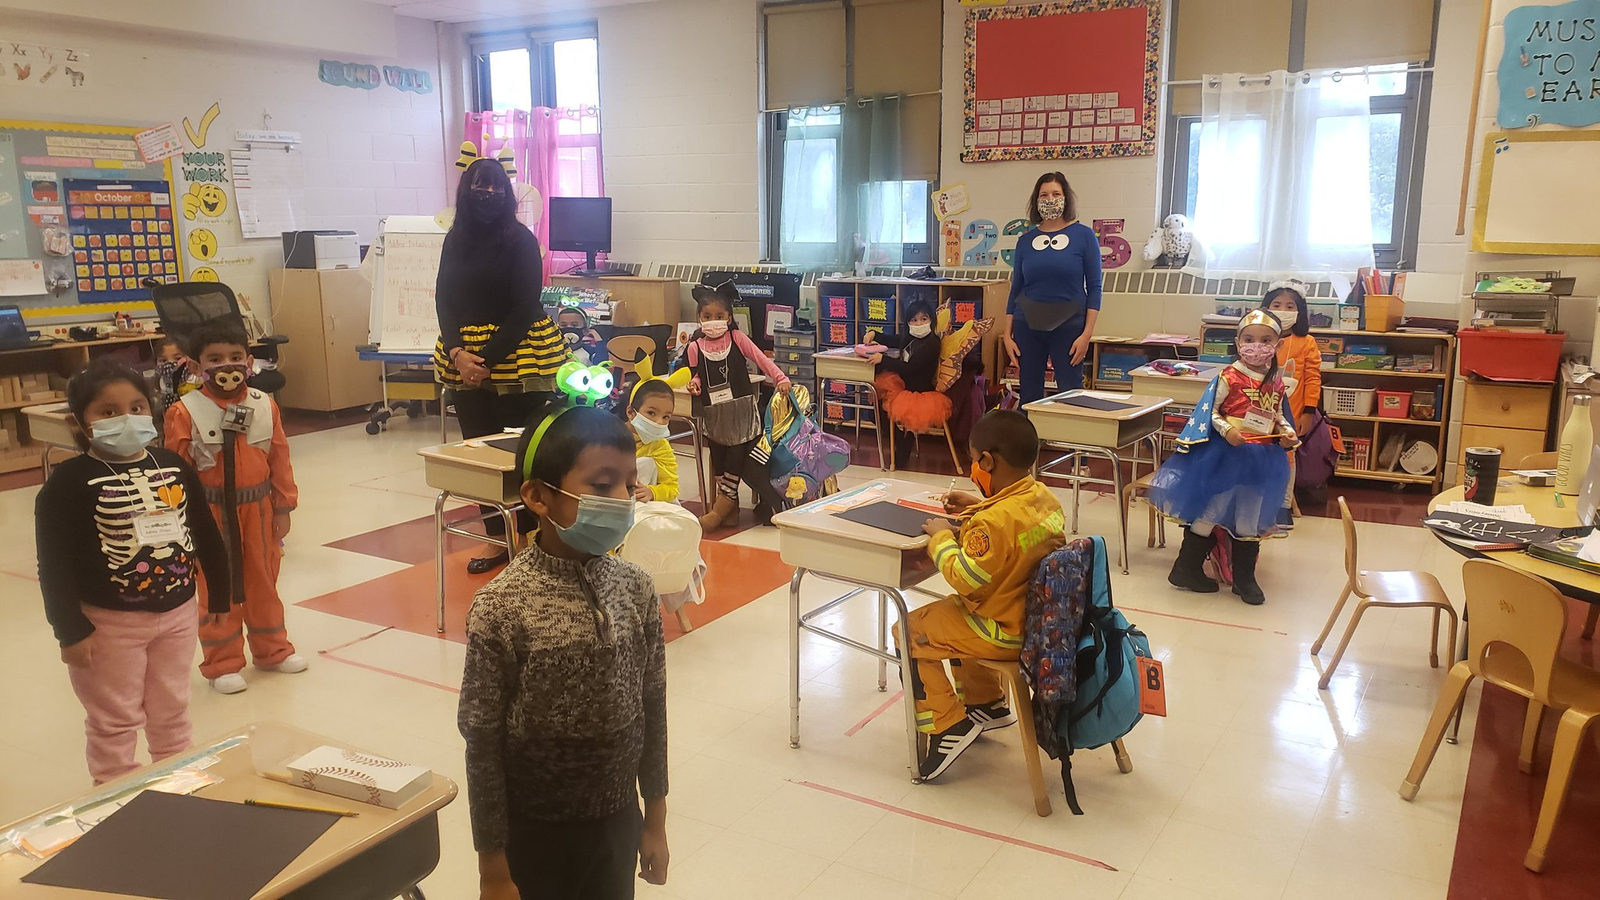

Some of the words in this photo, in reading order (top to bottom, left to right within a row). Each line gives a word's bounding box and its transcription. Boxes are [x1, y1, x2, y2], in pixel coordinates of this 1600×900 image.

[65, 49, 79, 62] Zz
[1533, 53, 1575, 75] TO
[182, 151, 226, 167] YOUR
[181, 166, 229, 182] WORK
[94, 193, 132, 203] October
[1102, 237, 1116, 246] five
[541, 286, 570, 294] DELINE
[1330, 427, 1339, 440] B
[1146, 666, 1161, 690] B
